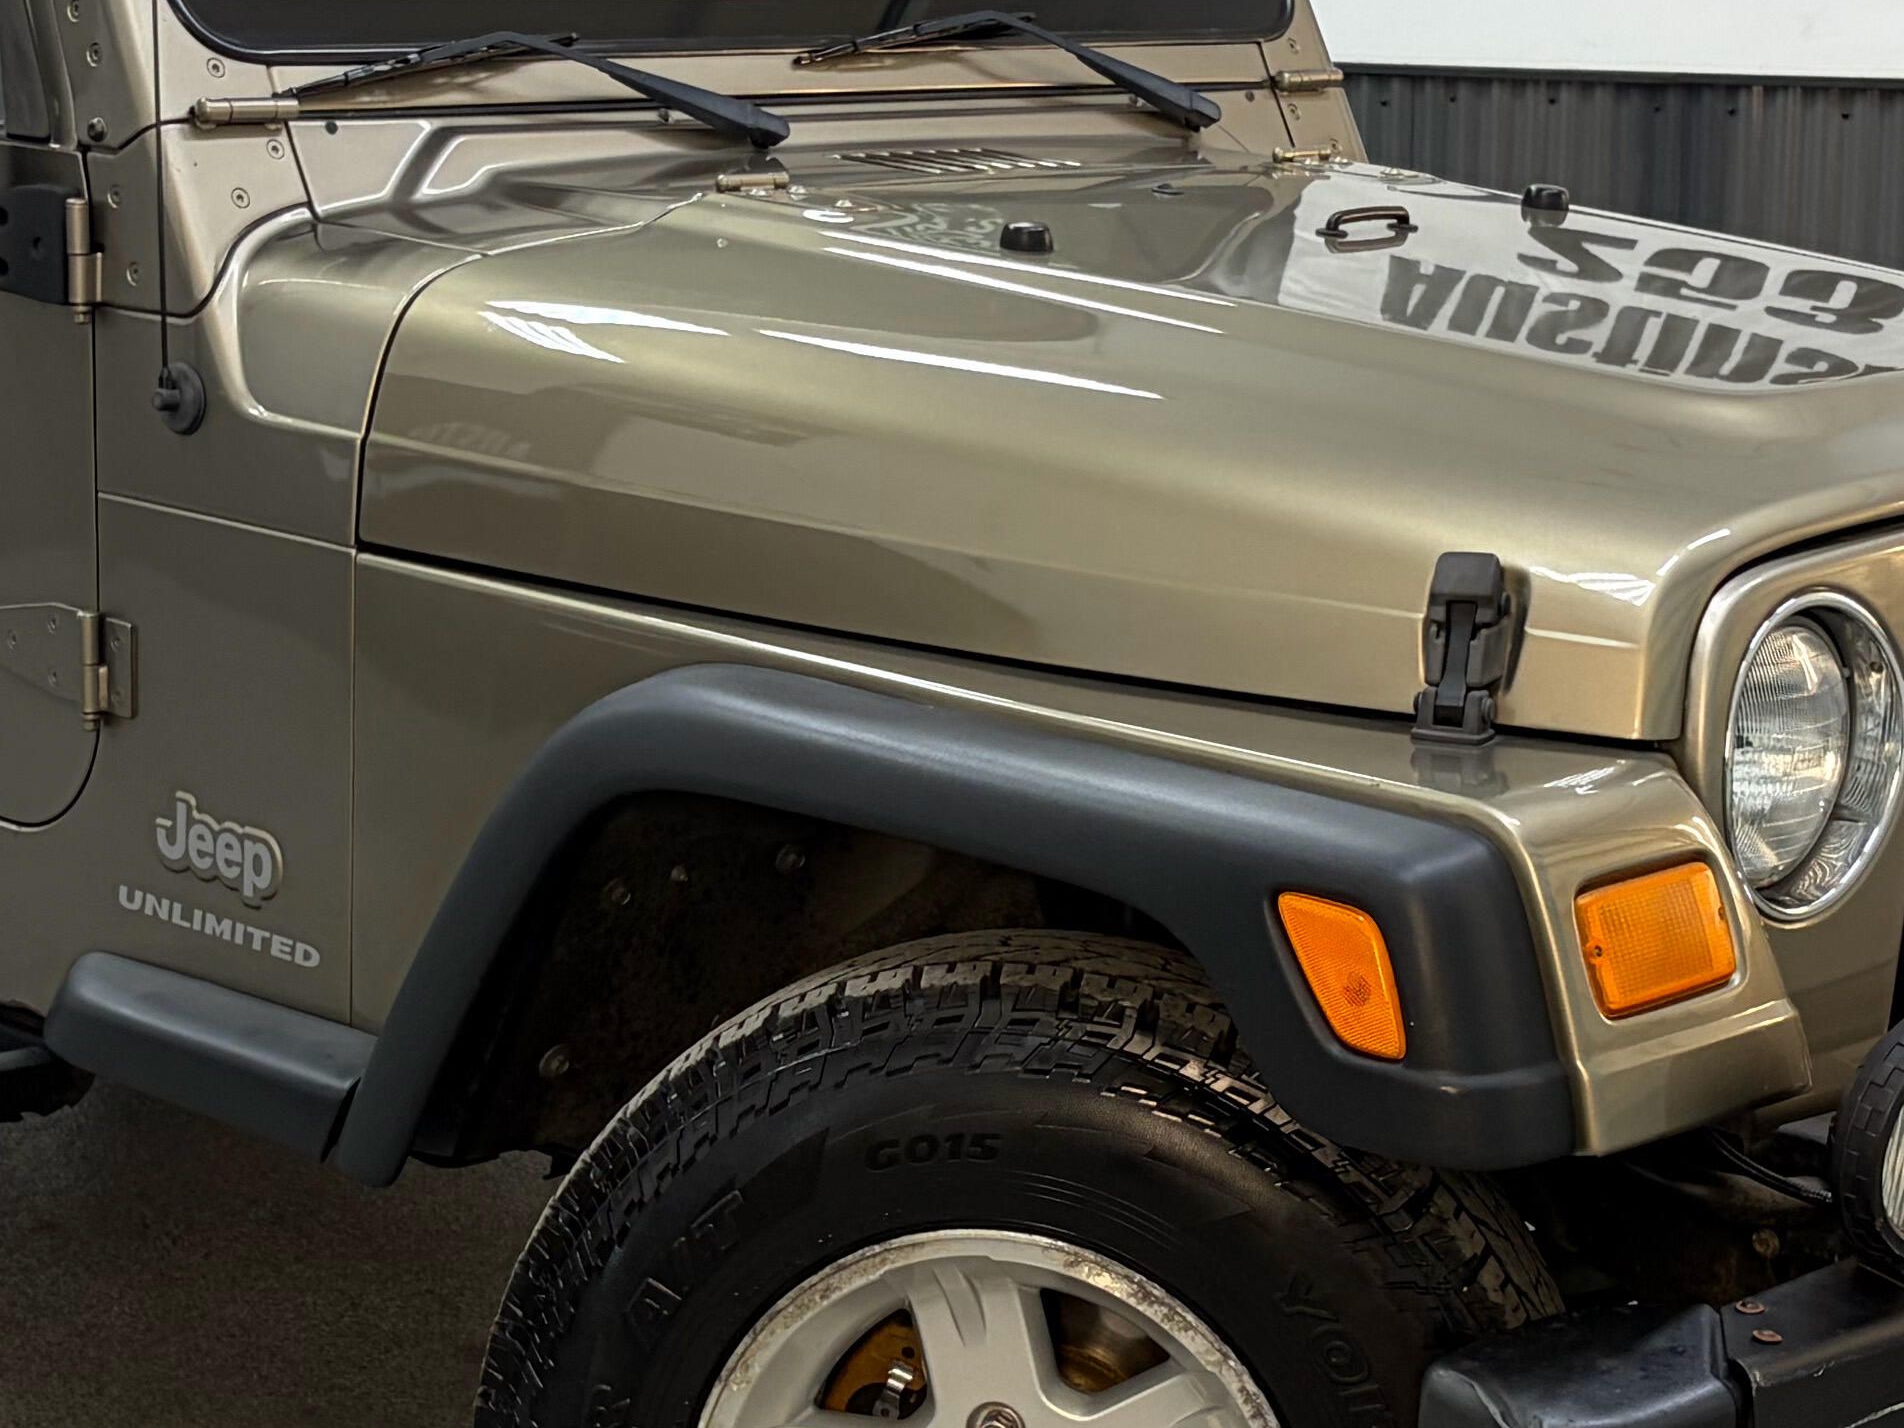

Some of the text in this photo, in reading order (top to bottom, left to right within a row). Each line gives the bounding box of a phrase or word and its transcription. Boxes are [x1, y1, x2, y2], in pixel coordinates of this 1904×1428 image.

[156, 790, 283, 908] Jeep
[118, 883, 321, 968] UNLIMITED
[864, 1131, 1002, 1173] G015
